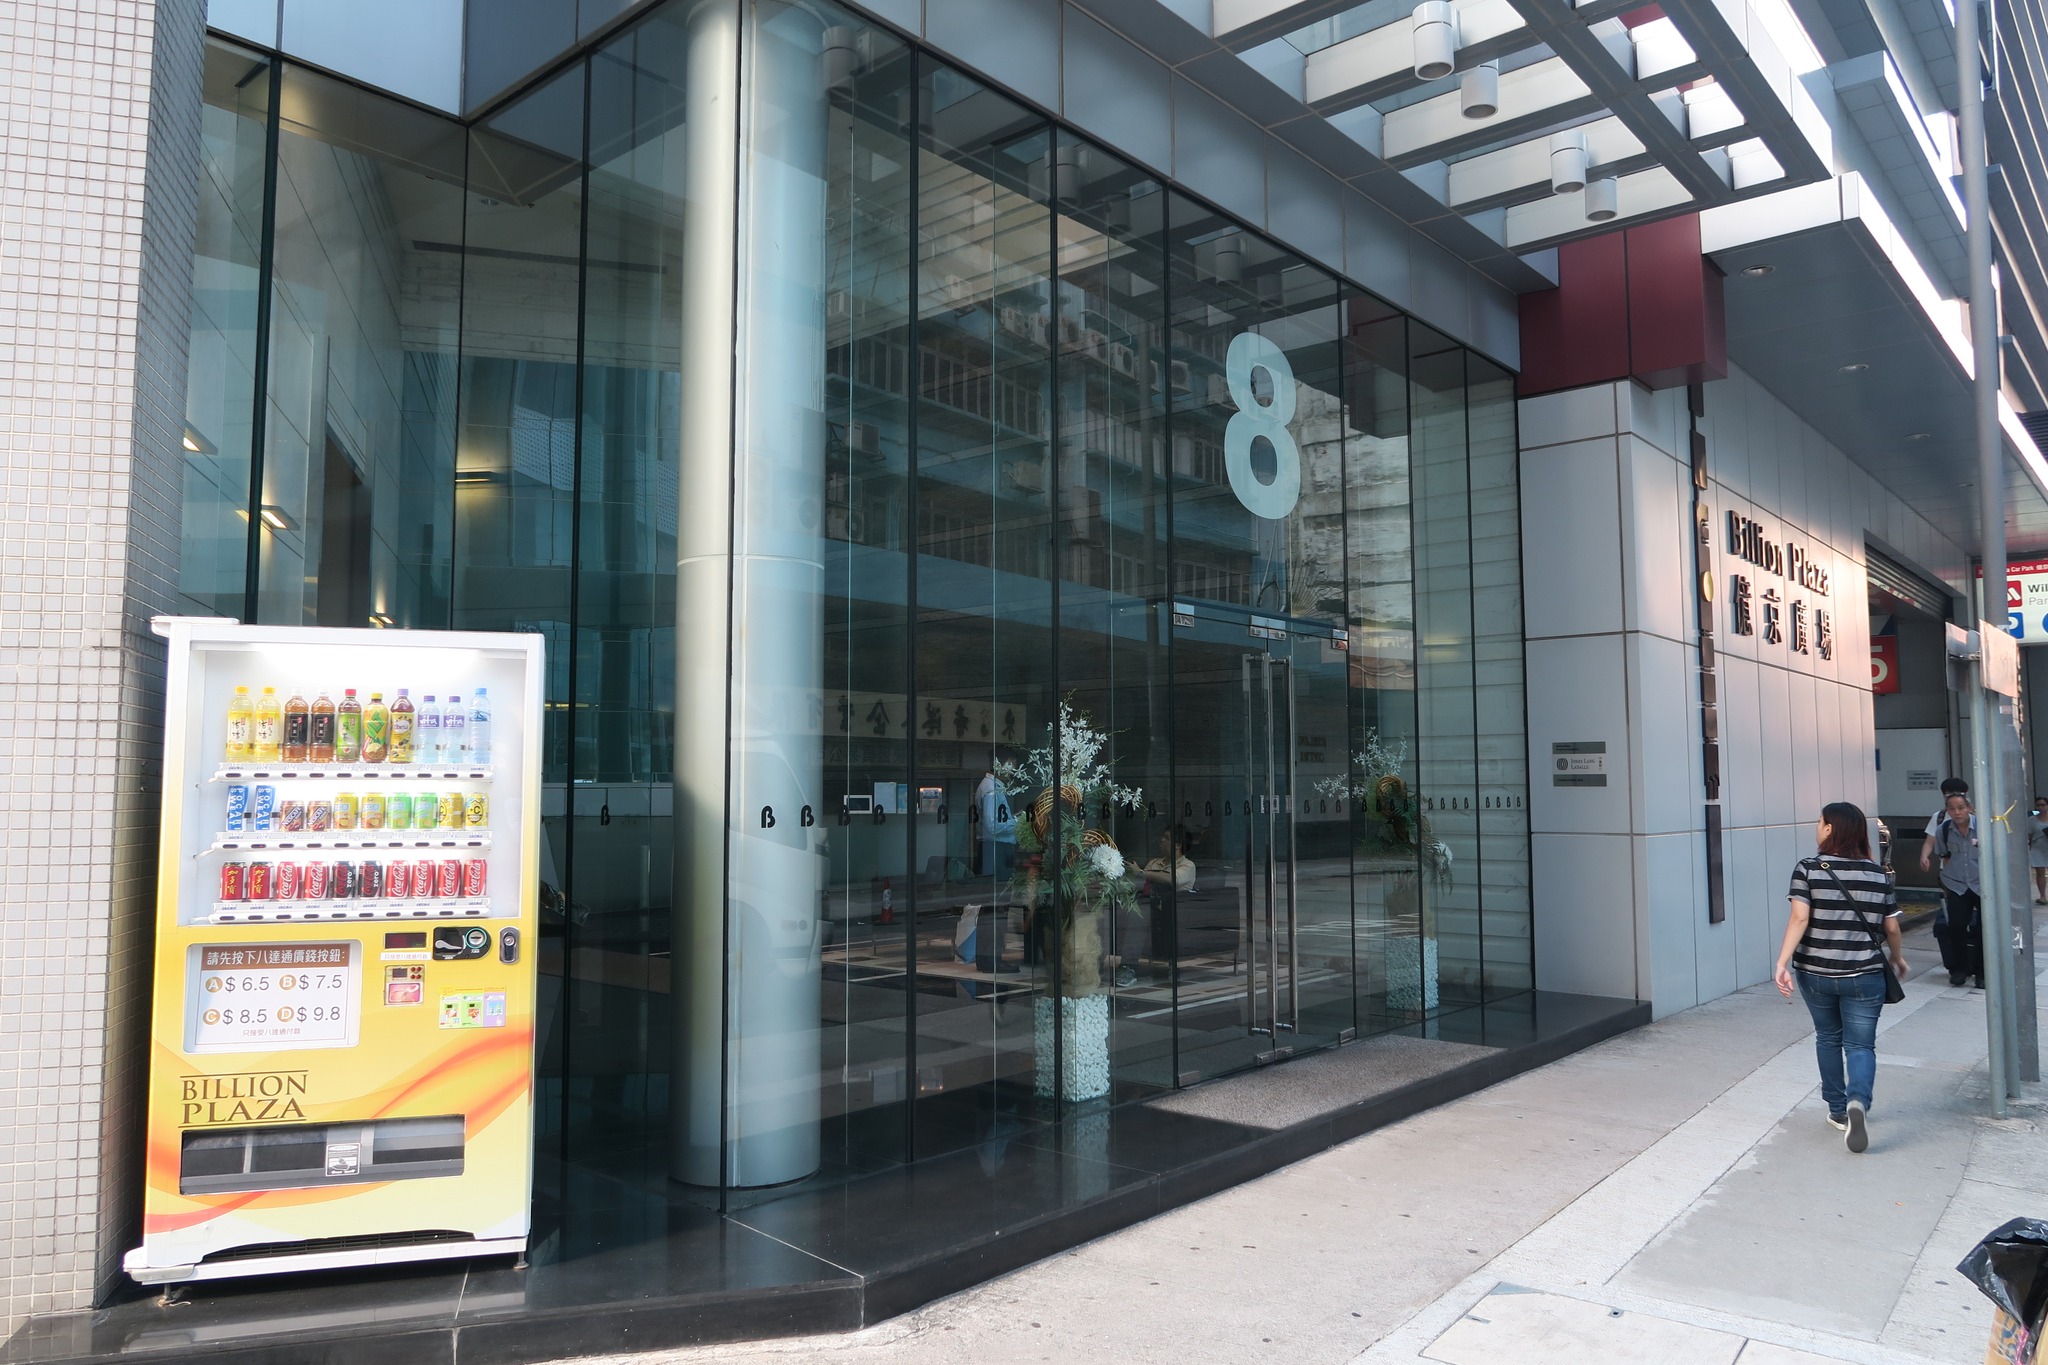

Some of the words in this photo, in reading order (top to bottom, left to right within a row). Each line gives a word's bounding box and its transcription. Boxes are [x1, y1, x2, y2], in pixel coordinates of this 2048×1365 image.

[1224, 332, 1300, 520] 8
[1727, 510, 1784, 576] Billion
[1788, 543, 1830, 597] Plaza
[2028, 583, 2048, 593] Wil
[1731, 574, 1832, 661] 億京廣場
[229, 788, 238, 825] SWEAT
[234, 788, 243, 830] POCARI
[257, 788, 265, 825] SWEAT
[262, 788, 271, 830] POCARI
[182, 1074, 308, 1101] BILLION
[182, 1097, 306, 1124] PLAZA
